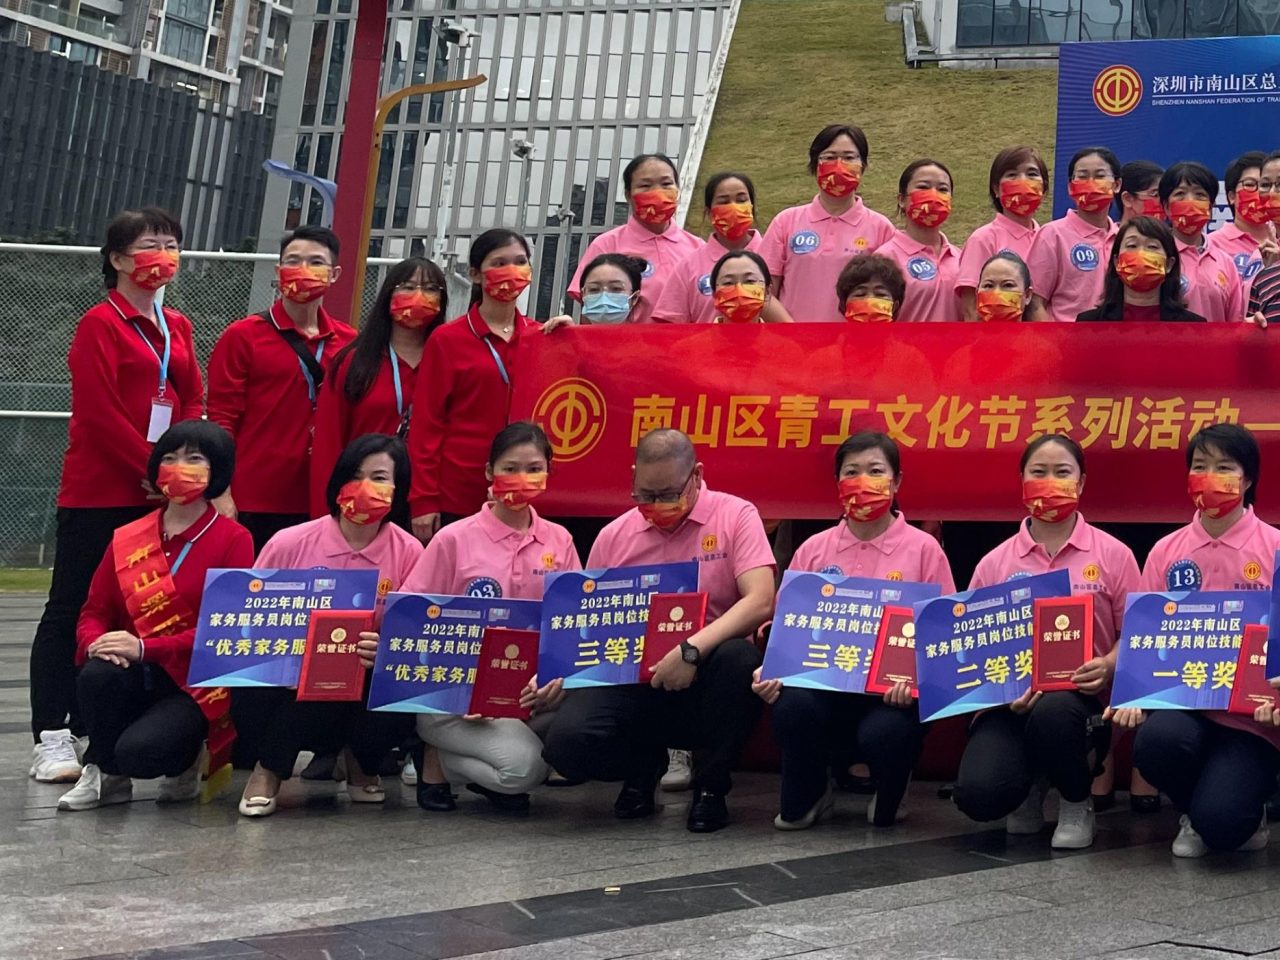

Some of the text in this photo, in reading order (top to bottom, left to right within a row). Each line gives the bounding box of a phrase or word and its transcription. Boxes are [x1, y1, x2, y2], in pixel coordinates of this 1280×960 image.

[795, 234, 815, 246] 06
[1076, 250, 1094, 262] 09
[912, 262, 931, 274] 05
[1174, 568, 1195, 587] 13
[244, 596, 333, 609] 2022年南山区
[209, 612, 310, 627] 家务服务员岗位
[953, 605, 1033, 634] 2022年南山区
[1160, 618, 1242, 632] 2022年南山区
[422, 623, 507, 638] 2022年南
[1043, 630, 1081, 642] 荣誉证书
[1152, 660, 1238, 690] 一等奖
